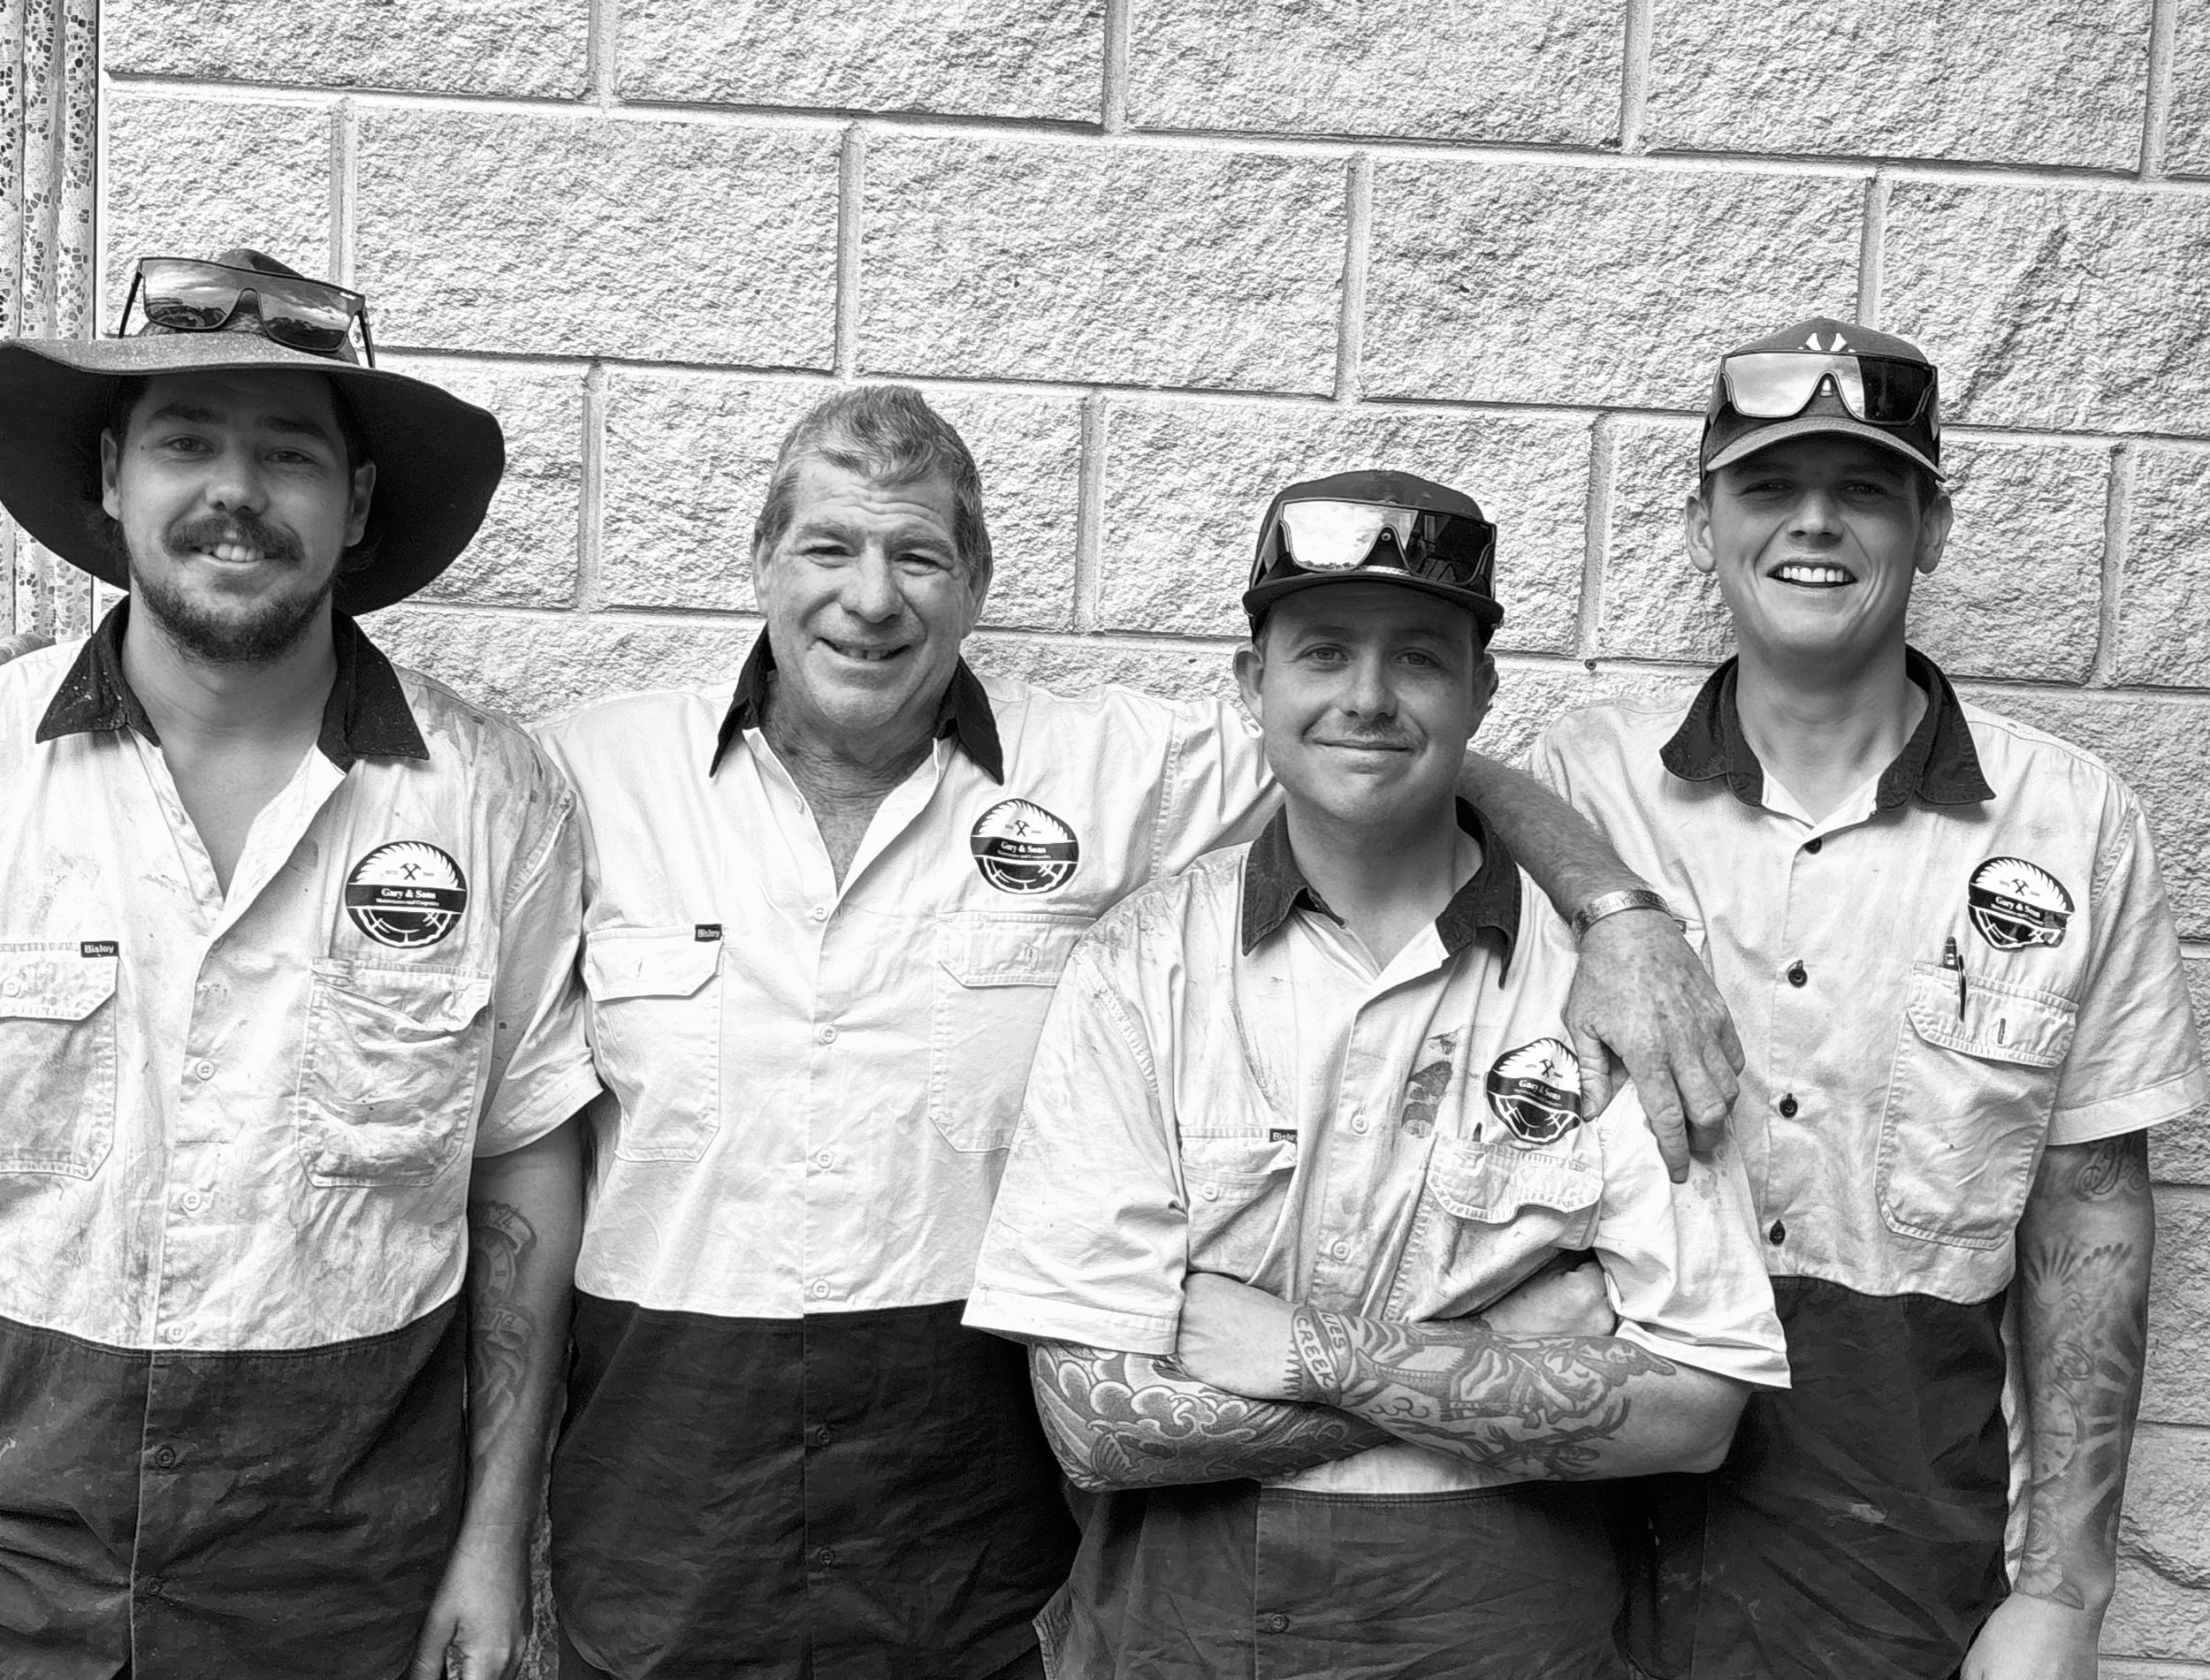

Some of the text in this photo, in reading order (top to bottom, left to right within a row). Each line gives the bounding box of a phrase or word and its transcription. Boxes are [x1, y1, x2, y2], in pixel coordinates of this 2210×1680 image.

[1018, 844, 1026, 853] &
[380, 887, 437, 900] Gary & Sons
[84, 943, 115, 954] Bisley
[1297, 1317, 1336, 1388] CREEK
